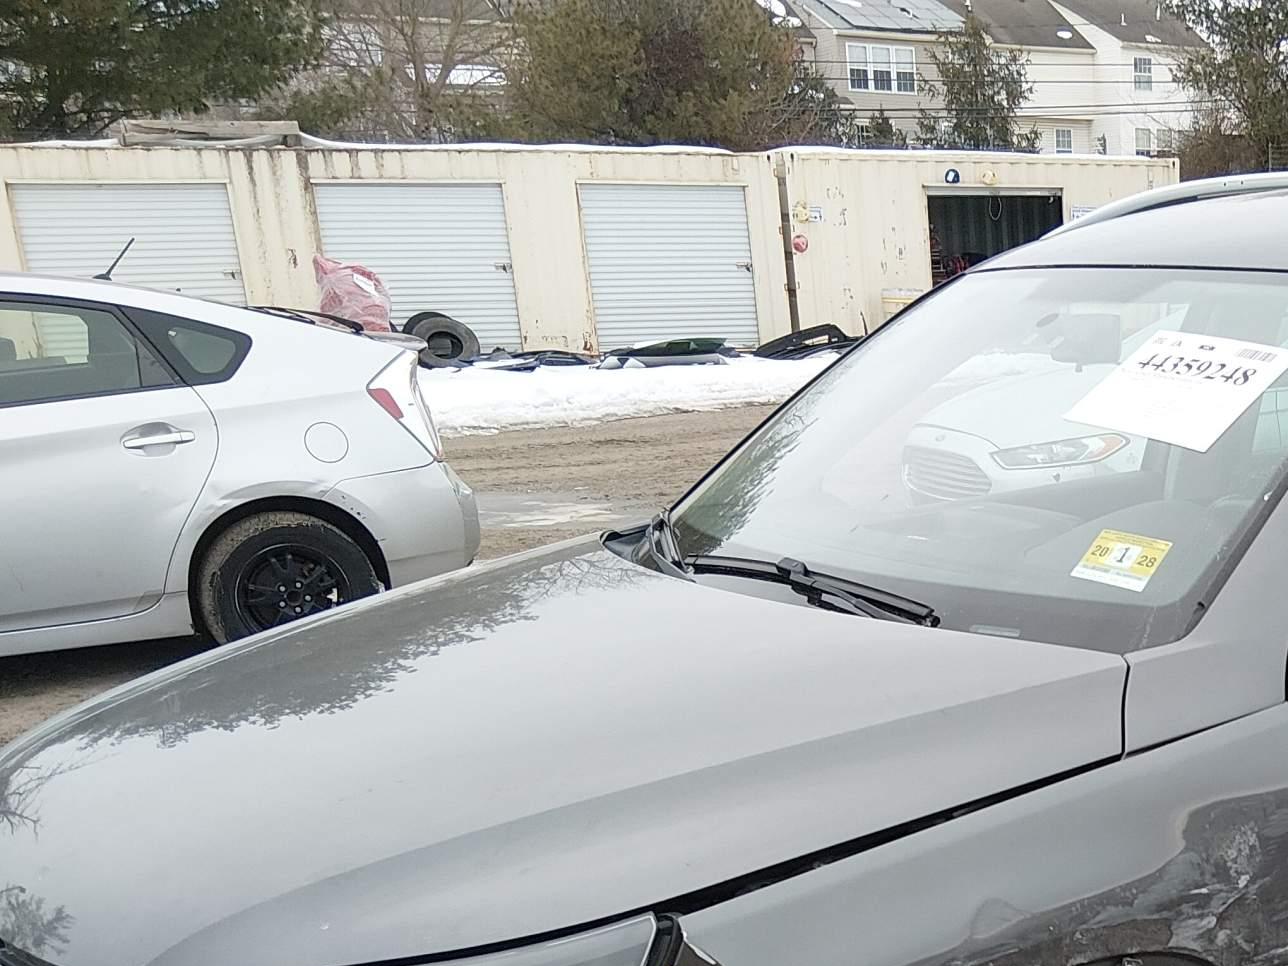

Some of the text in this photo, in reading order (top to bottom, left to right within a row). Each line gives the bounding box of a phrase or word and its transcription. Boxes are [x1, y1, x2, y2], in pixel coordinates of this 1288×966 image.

[1138, 353, 1257, 386] 44359248
[1091, 544, 1157, 568] 20 1 28
